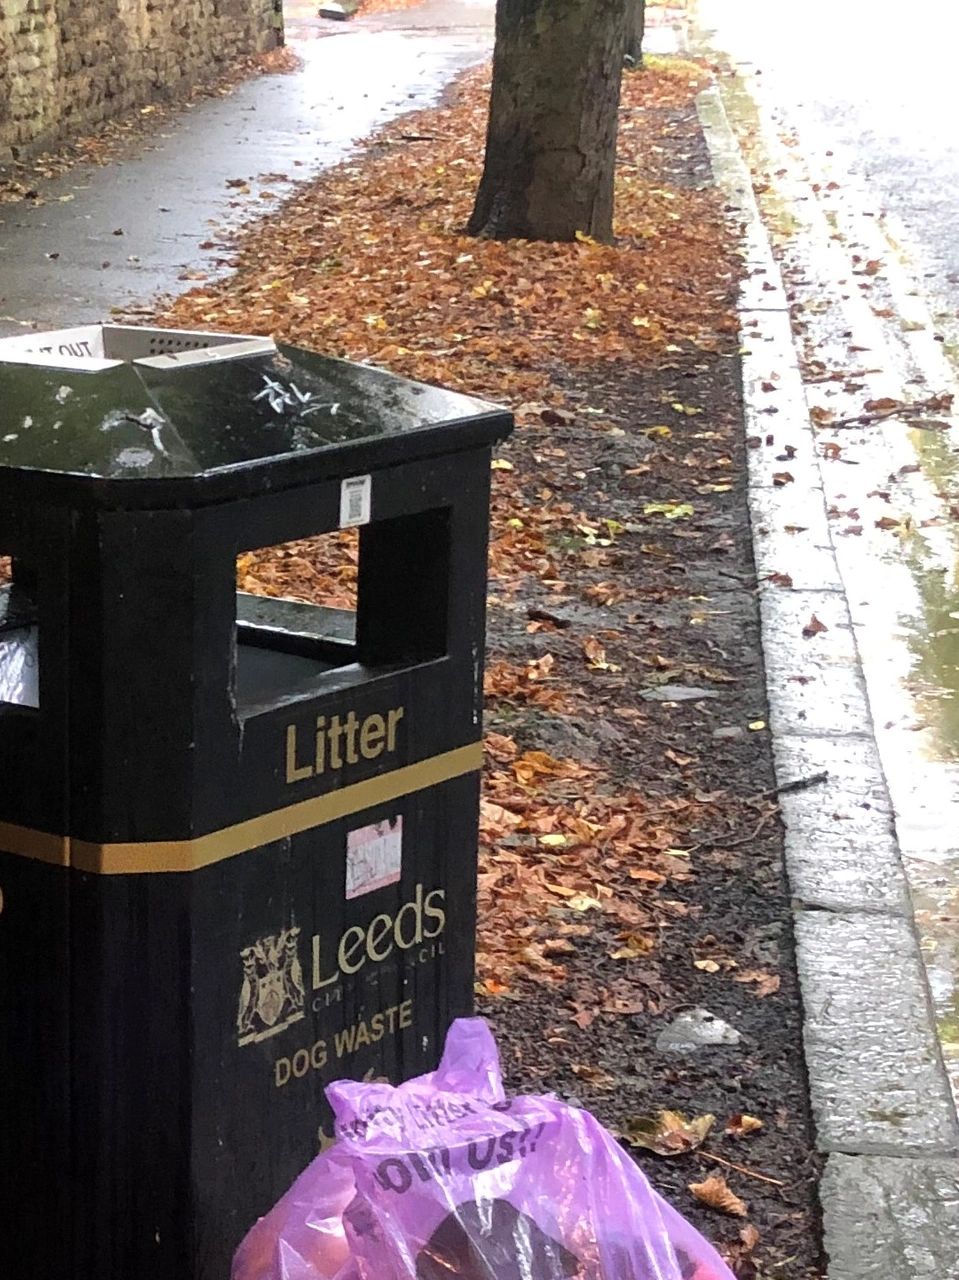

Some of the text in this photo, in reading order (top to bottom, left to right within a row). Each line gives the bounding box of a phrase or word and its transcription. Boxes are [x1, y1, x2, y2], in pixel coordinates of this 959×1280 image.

[286, 704, 405, 784] Litter
[312, 883, 446, 990] Leeds
[275, 999, 413, 1088] DOG WASTE
